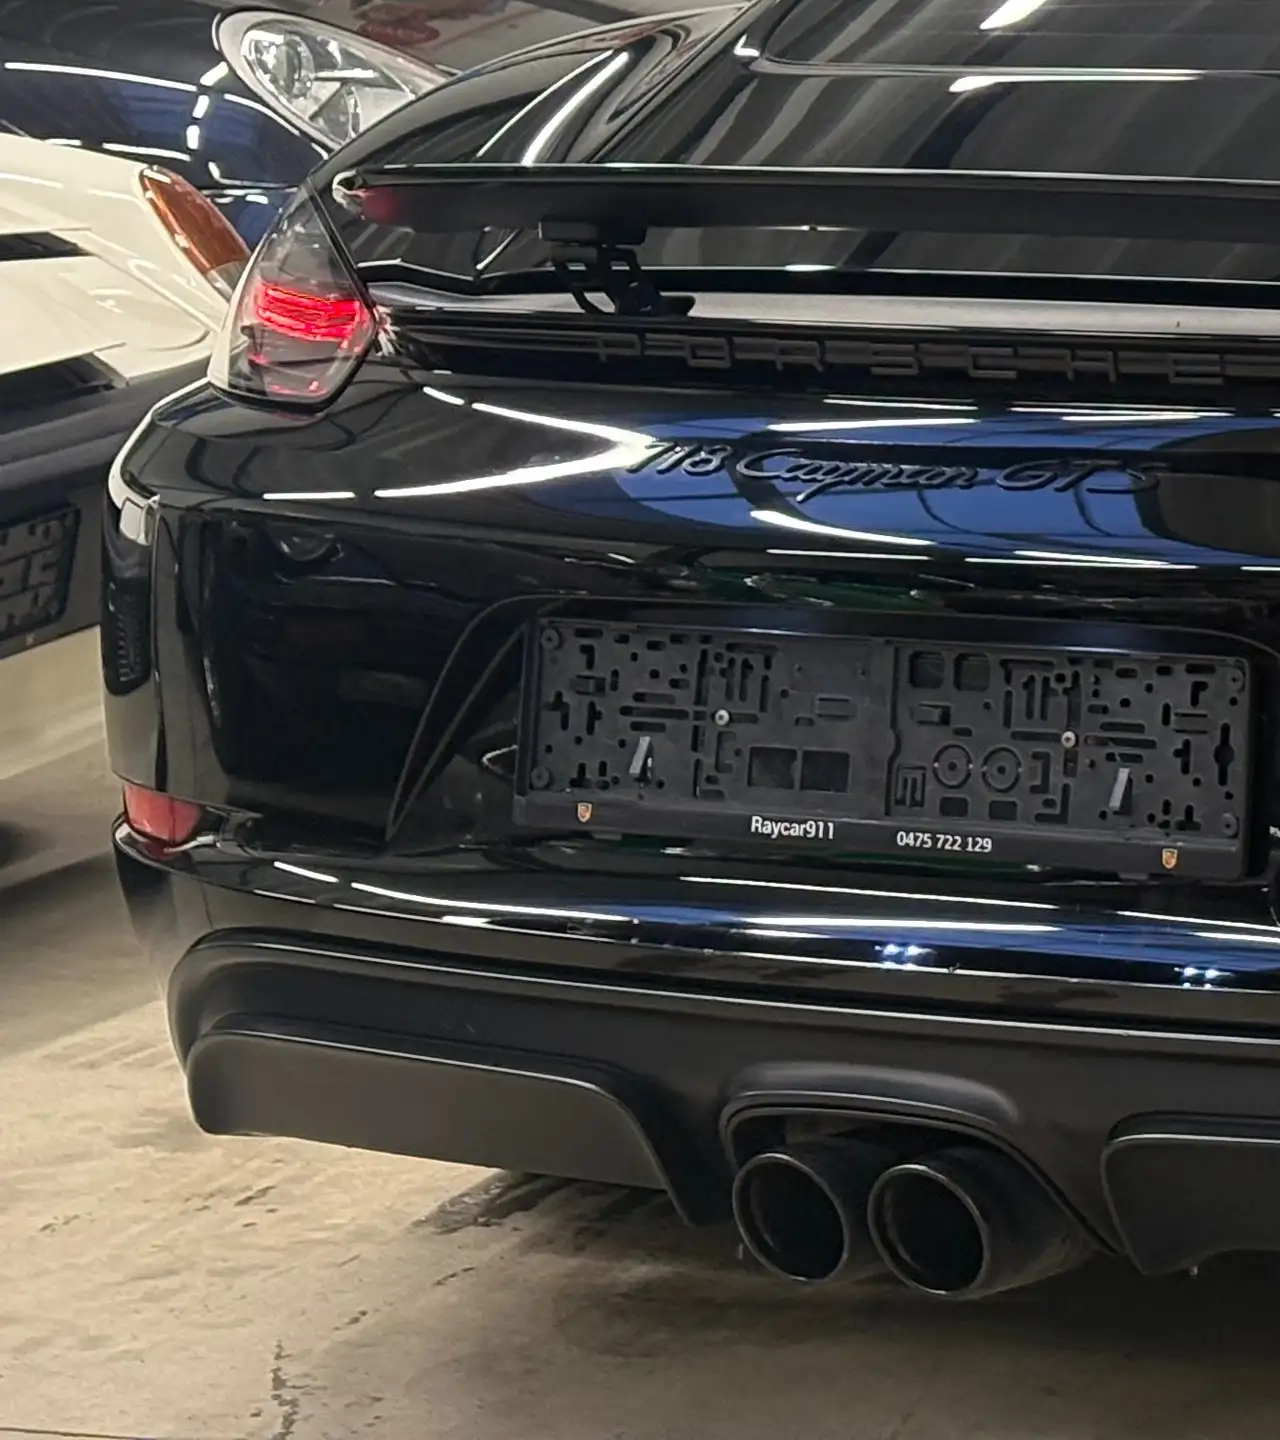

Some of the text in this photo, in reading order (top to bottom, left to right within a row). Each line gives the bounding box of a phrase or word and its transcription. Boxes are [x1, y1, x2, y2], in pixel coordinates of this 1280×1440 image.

[598, 333, 1224, 386] PORSCHE
[625, 439, 1167, 504] 718 Cayman GTS
[751, 815, 992, 853] Raycar911 0475 722 129
